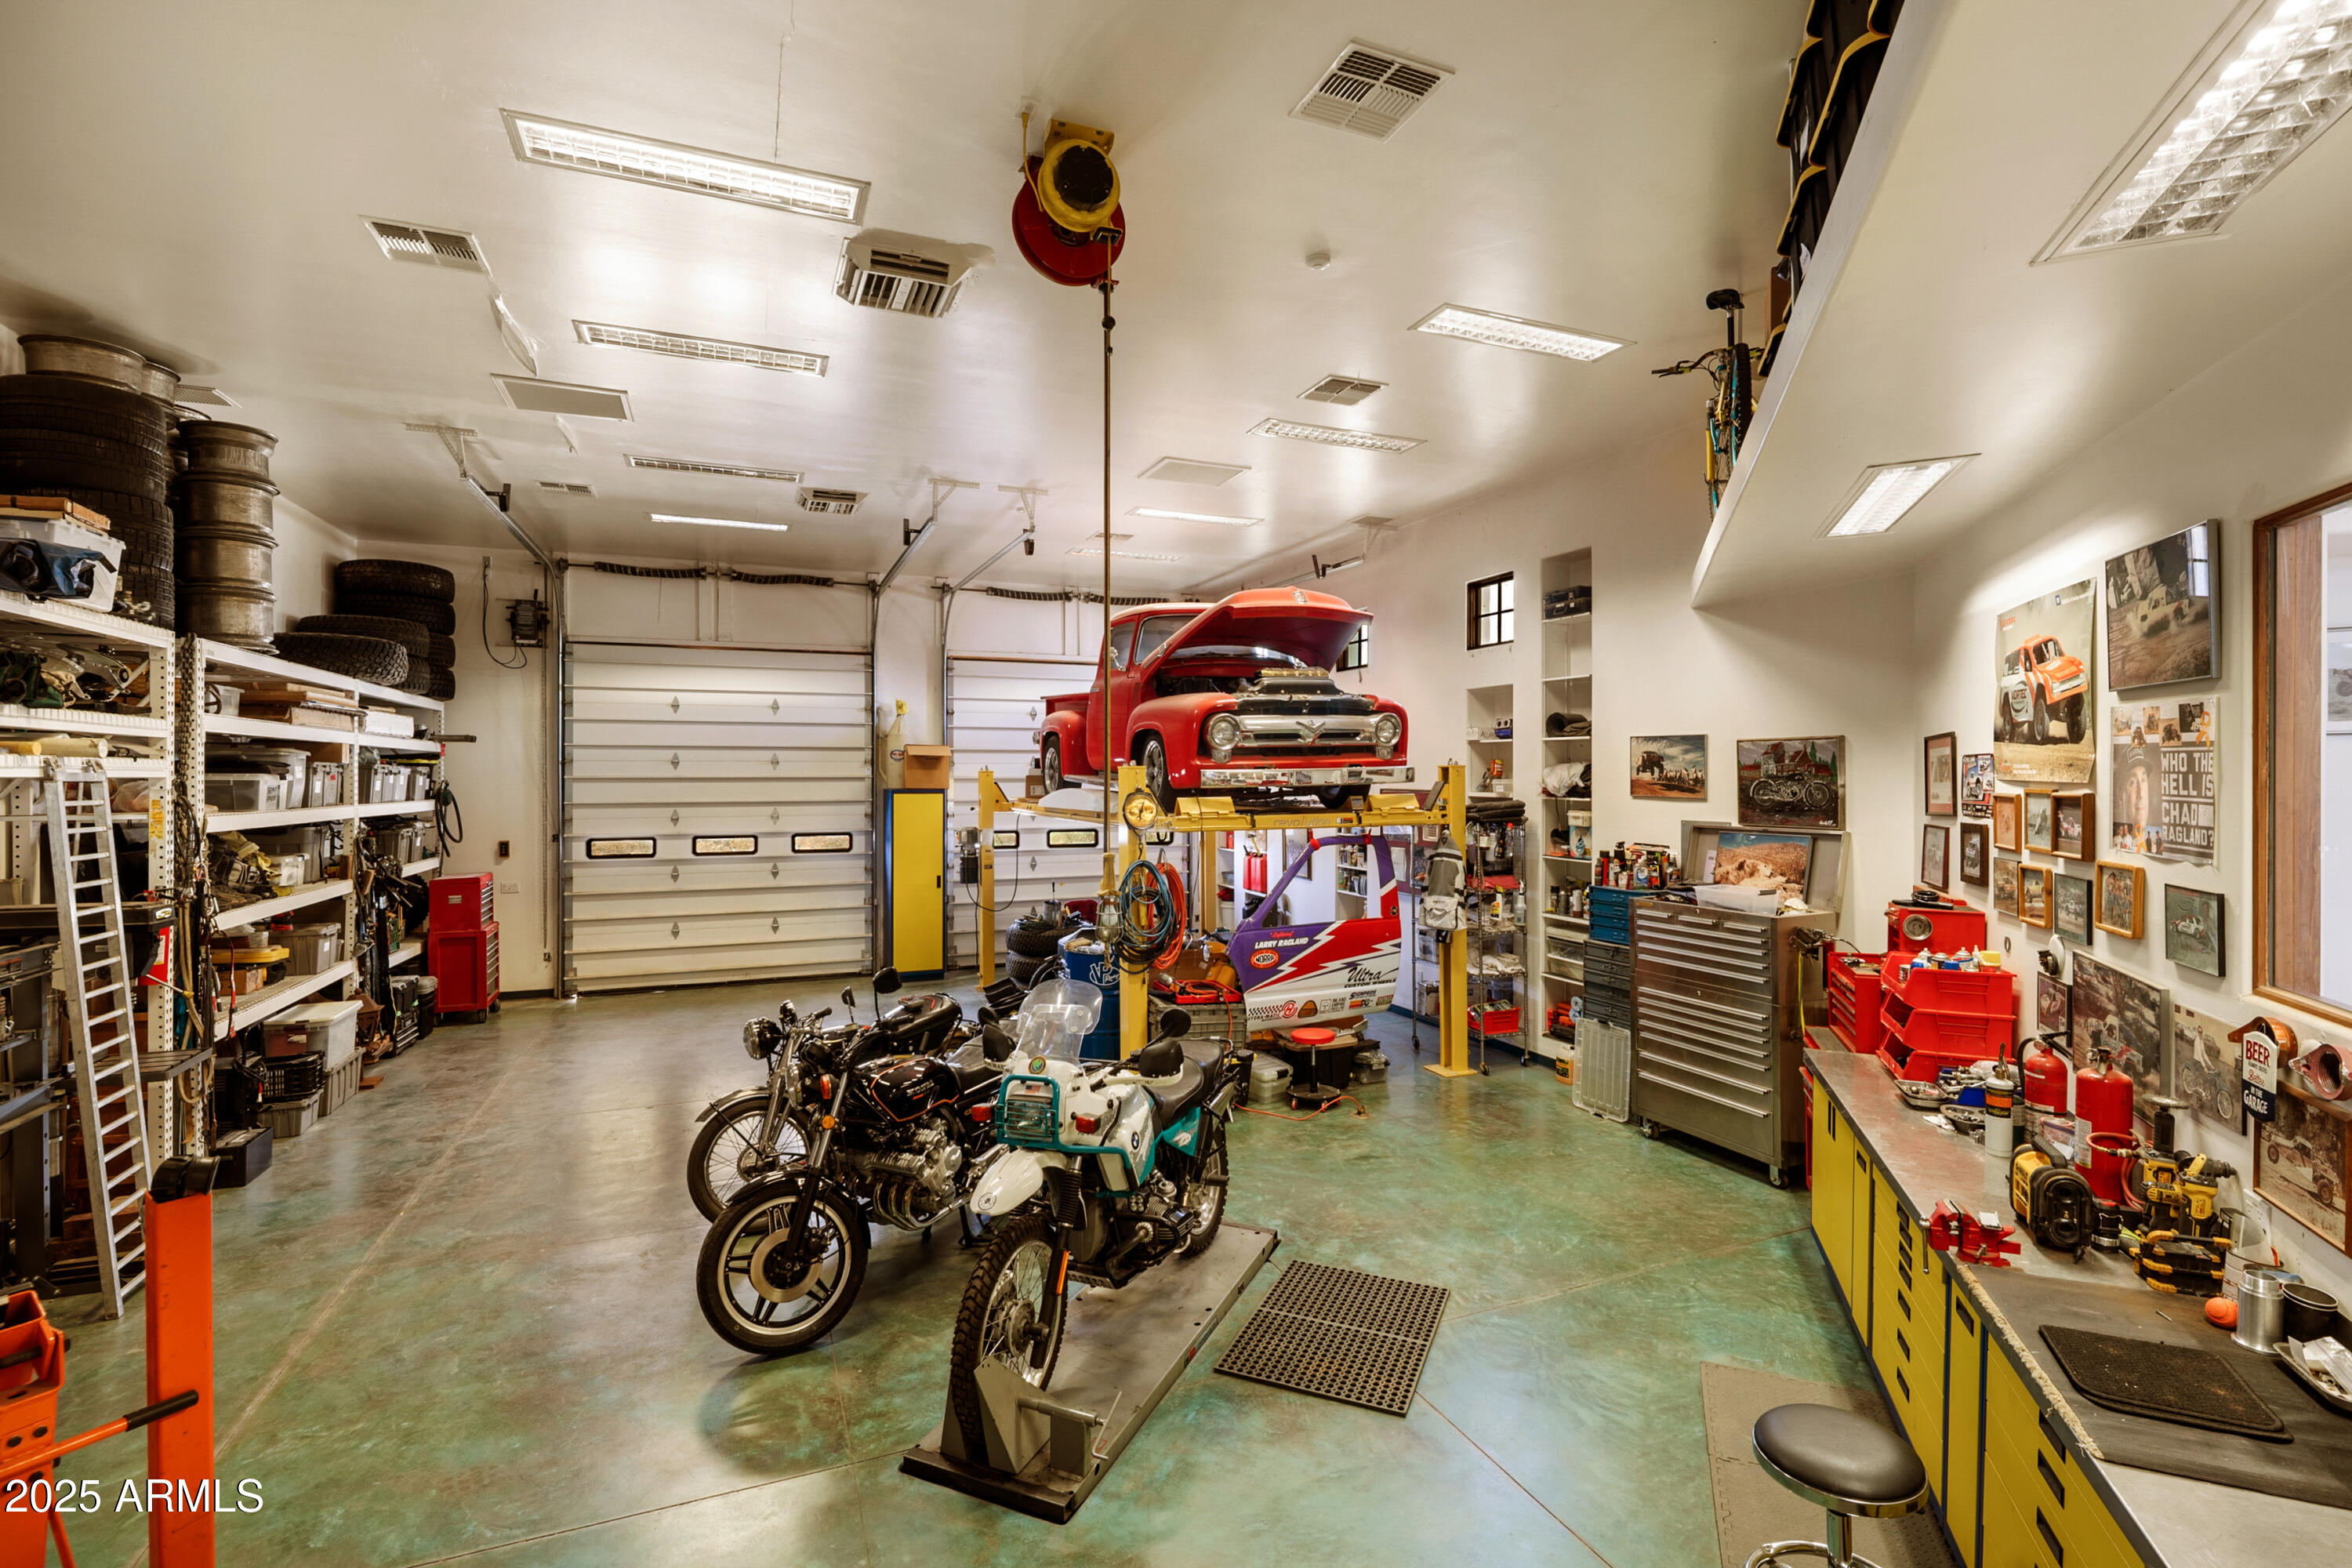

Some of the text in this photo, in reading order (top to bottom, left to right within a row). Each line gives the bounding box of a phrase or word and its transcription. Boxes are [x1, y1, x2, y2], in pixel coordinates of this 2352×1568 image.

[2012, 688, 2027, 700] VORTEC
[2161, 753, 2187, 772] WHO
[2193, 752, 2213, 772] THE
[2161, 773, 2213, 797] HELL IS
[1273, 815, 1330, 826] revolution
[2162, 801, 2198, 826] CHAD
[2162, 825, 2213, 847] RAGLAND?
[1254, 938, 1309, 949] LARRY RAGLAND
[1348, 966, 1381, 982] Ultra
[2245, 1040, 2270, 1067] BEER
[2244, 1091, 2268, 1114] GARAGE
